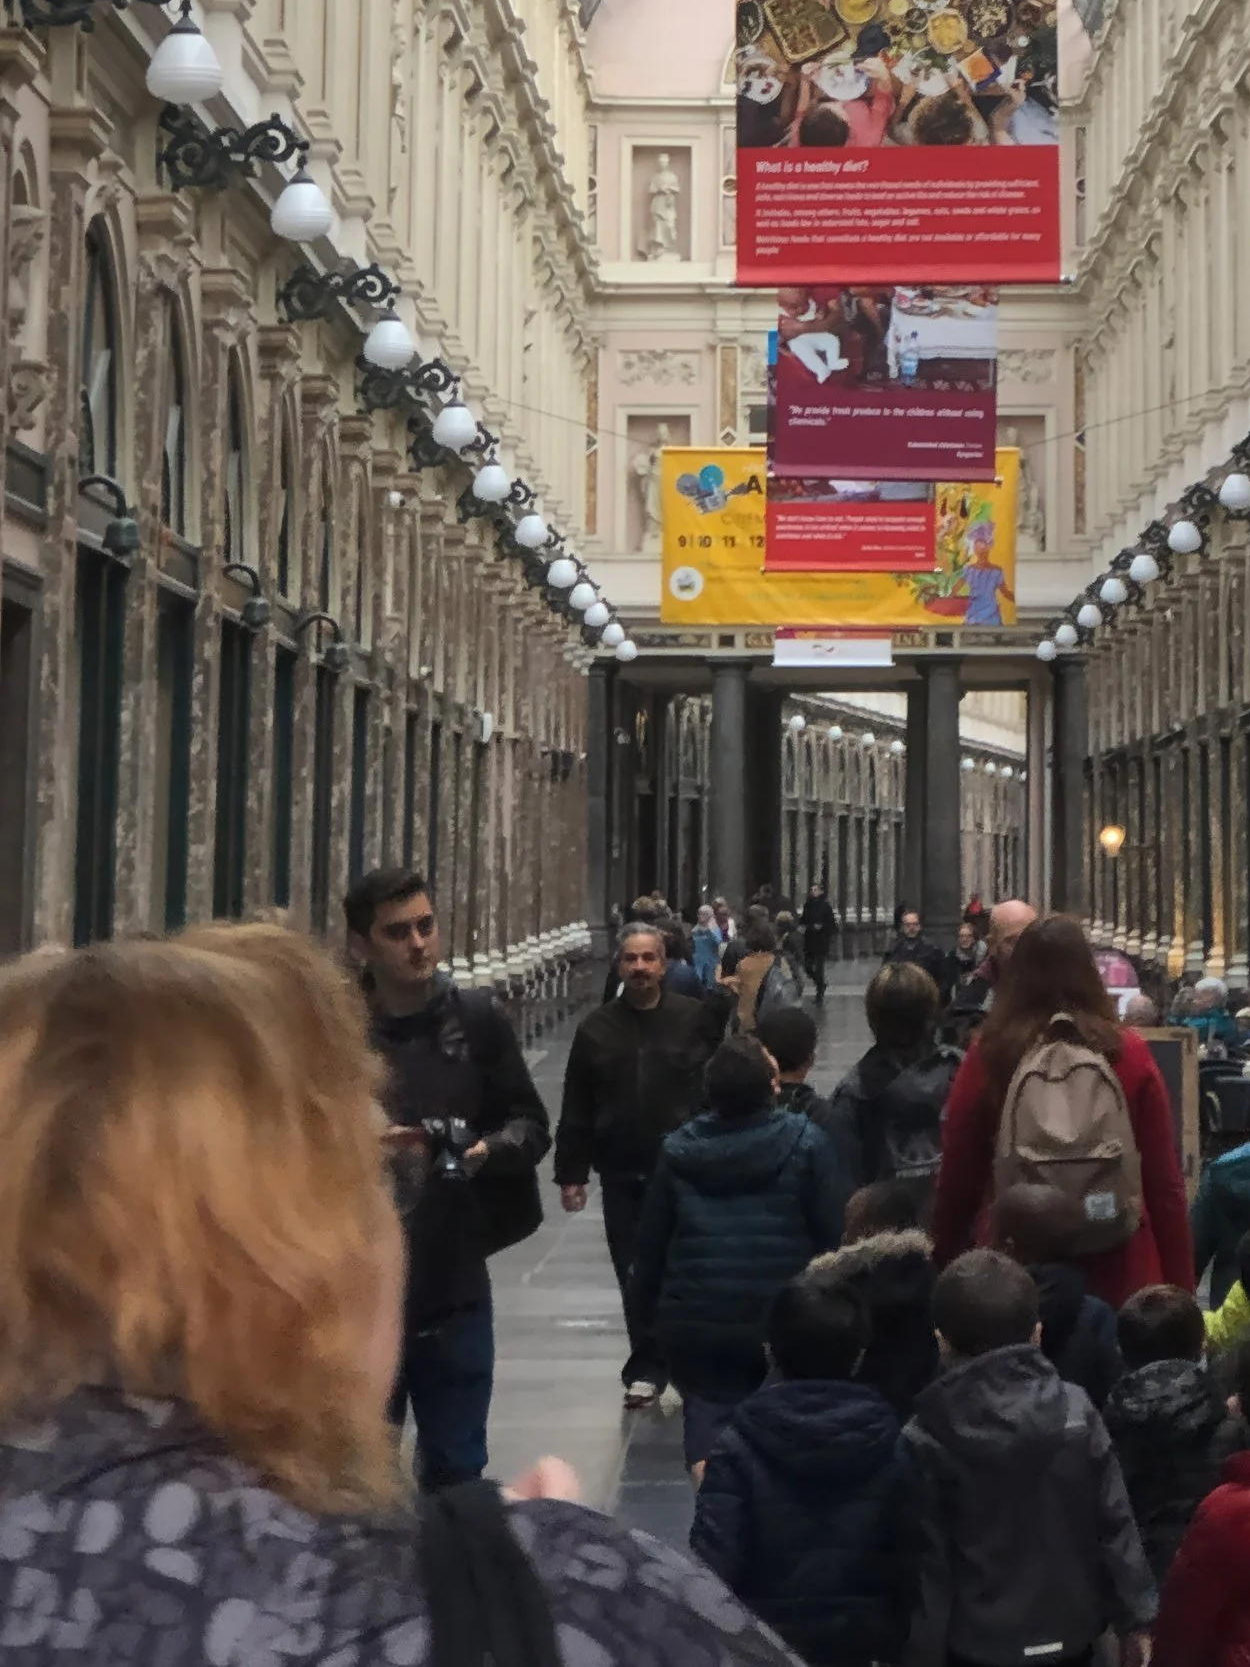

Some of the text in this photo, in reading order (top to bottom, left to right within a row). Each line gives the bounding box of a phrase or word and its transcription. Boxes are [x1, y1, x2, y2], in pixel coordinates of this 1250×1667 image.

[756, 160, 782, 173] What
[783, 160, 794, 173] is
[794, 162, 802, 173] a
